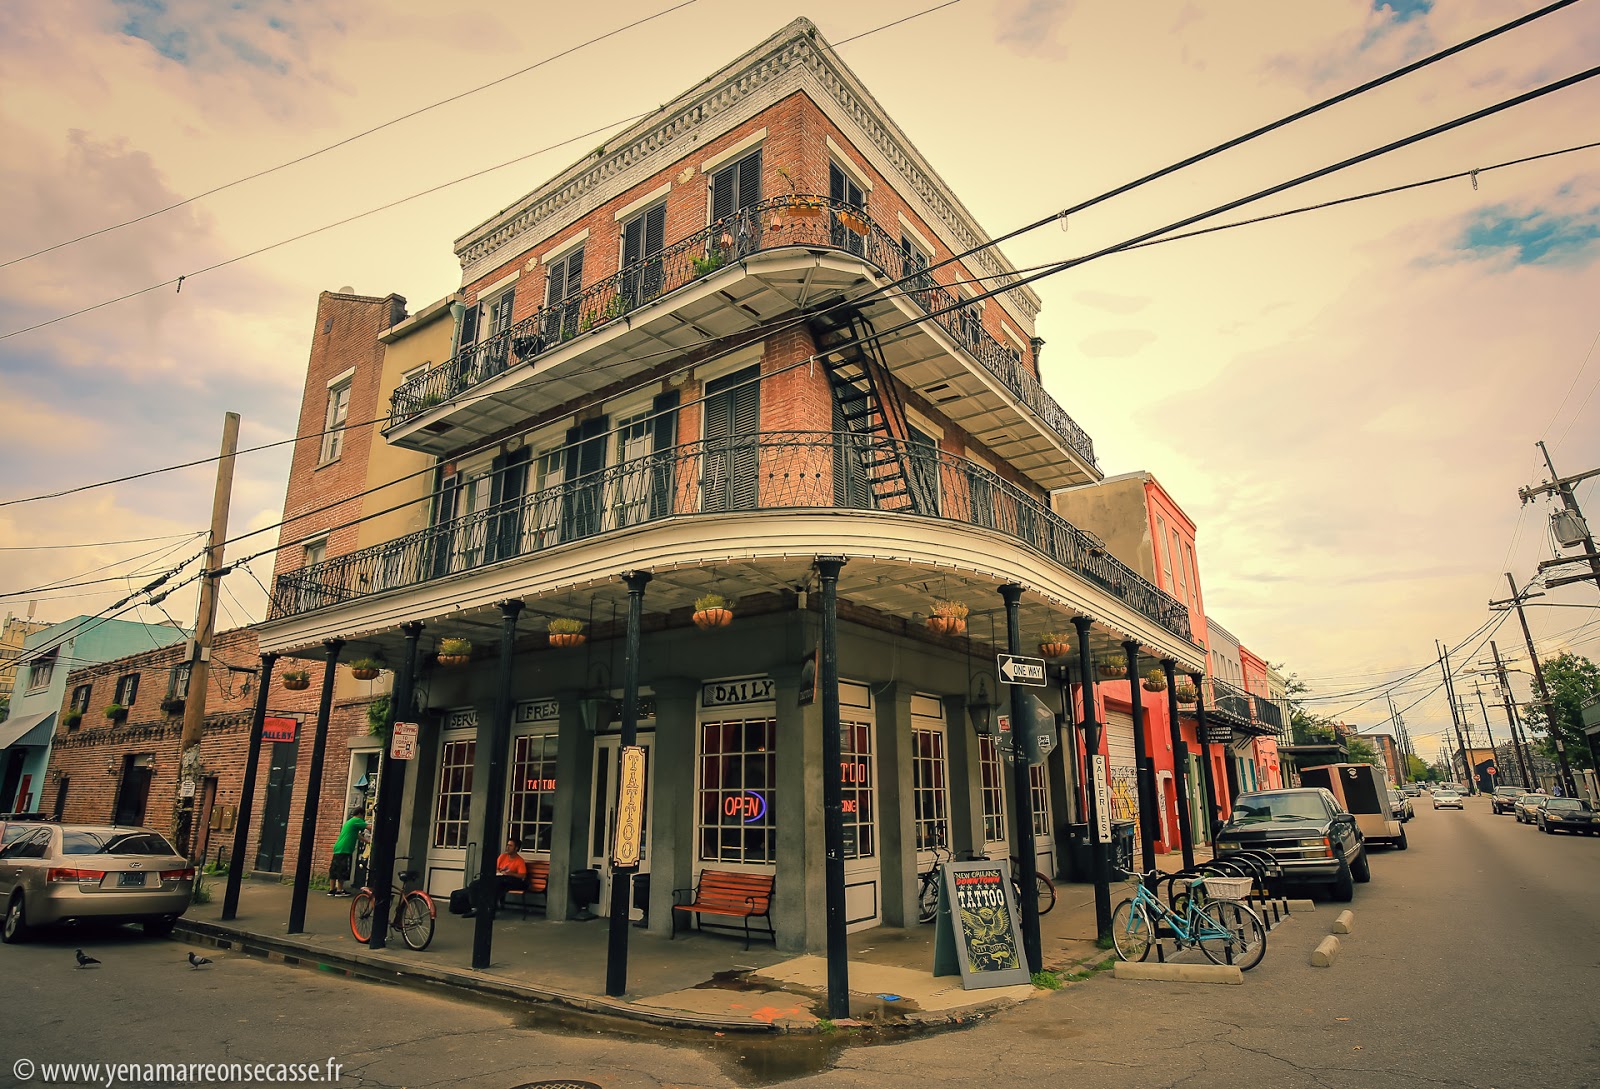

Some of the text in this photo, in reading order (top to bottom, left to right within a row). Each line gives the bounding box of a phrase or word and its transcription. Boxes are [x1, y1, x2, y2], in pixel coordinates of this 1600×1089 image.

[1013, 664, 1041, 678] ONE WAY
[715, 680, 774, 702] DAILY
[526, 702, 559, 719] FRES
[840, 762, 866, 783] TOO
[1095, 757, 1108, 832] GALLERIES
[621, 755, 639, 859] TATTOO
[724, 797, 759, 816] OPEN
[955, 876, 1001, 885] DOWNTOWN
[958, 889, 1004, 908] TATTOO
